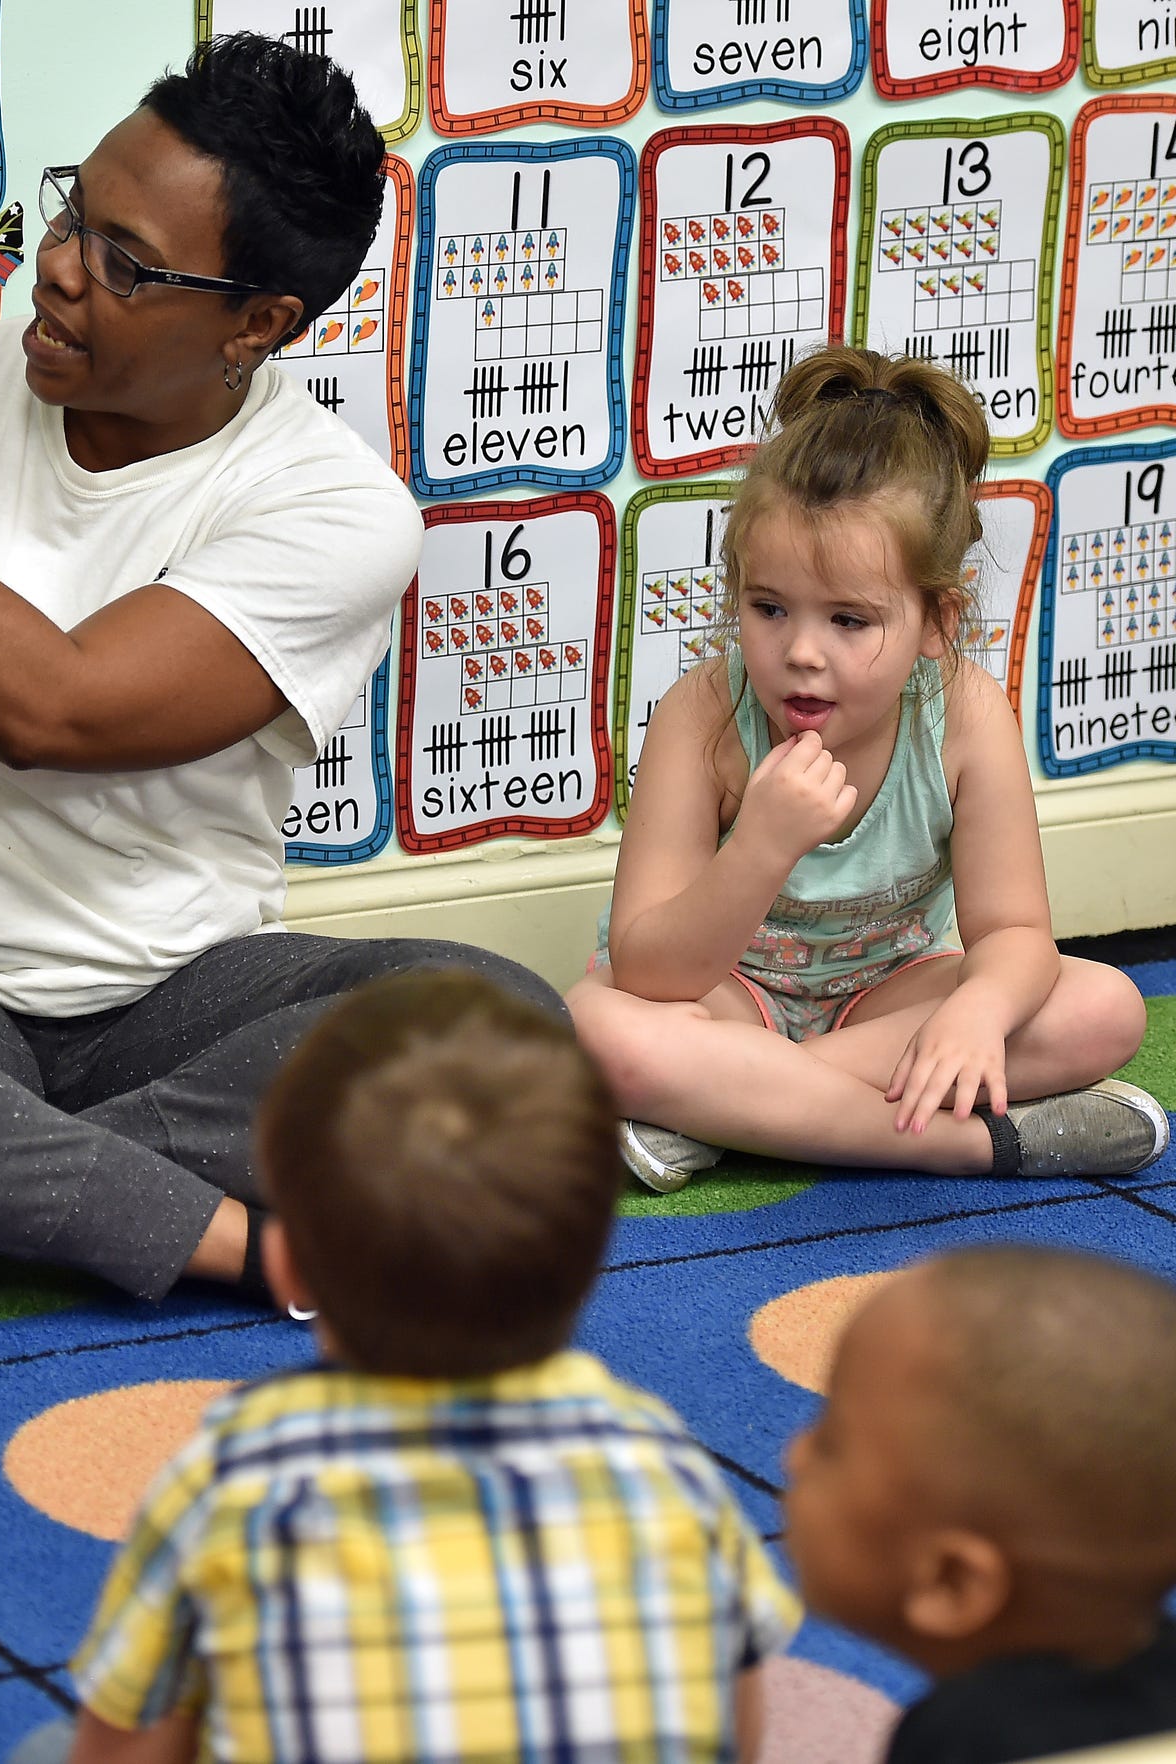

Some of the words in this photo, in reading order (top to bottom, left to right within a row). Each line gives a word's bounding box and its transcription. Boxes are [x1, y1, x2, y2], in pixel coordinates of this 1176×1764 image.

[919, 13, 1027, 67] eight
[1139, 8, 1176, 51] ni
[511, 50, 567, 92] six
[693, 36, 822, 76] seven
[725, 152, 772, 212] 12
[943, 141, 992, 205] 13
[511, 170, 550, 230] 11
[1072, 357, 1176, 398] fourt
[443, 422, 585, 467] eleven
[1124, 463, 1165, 526] 19
[484, 524, 532, 588] 16
[1055, 702, 1176, 751] ninete
[422, 767, 583, 818] sixteen
